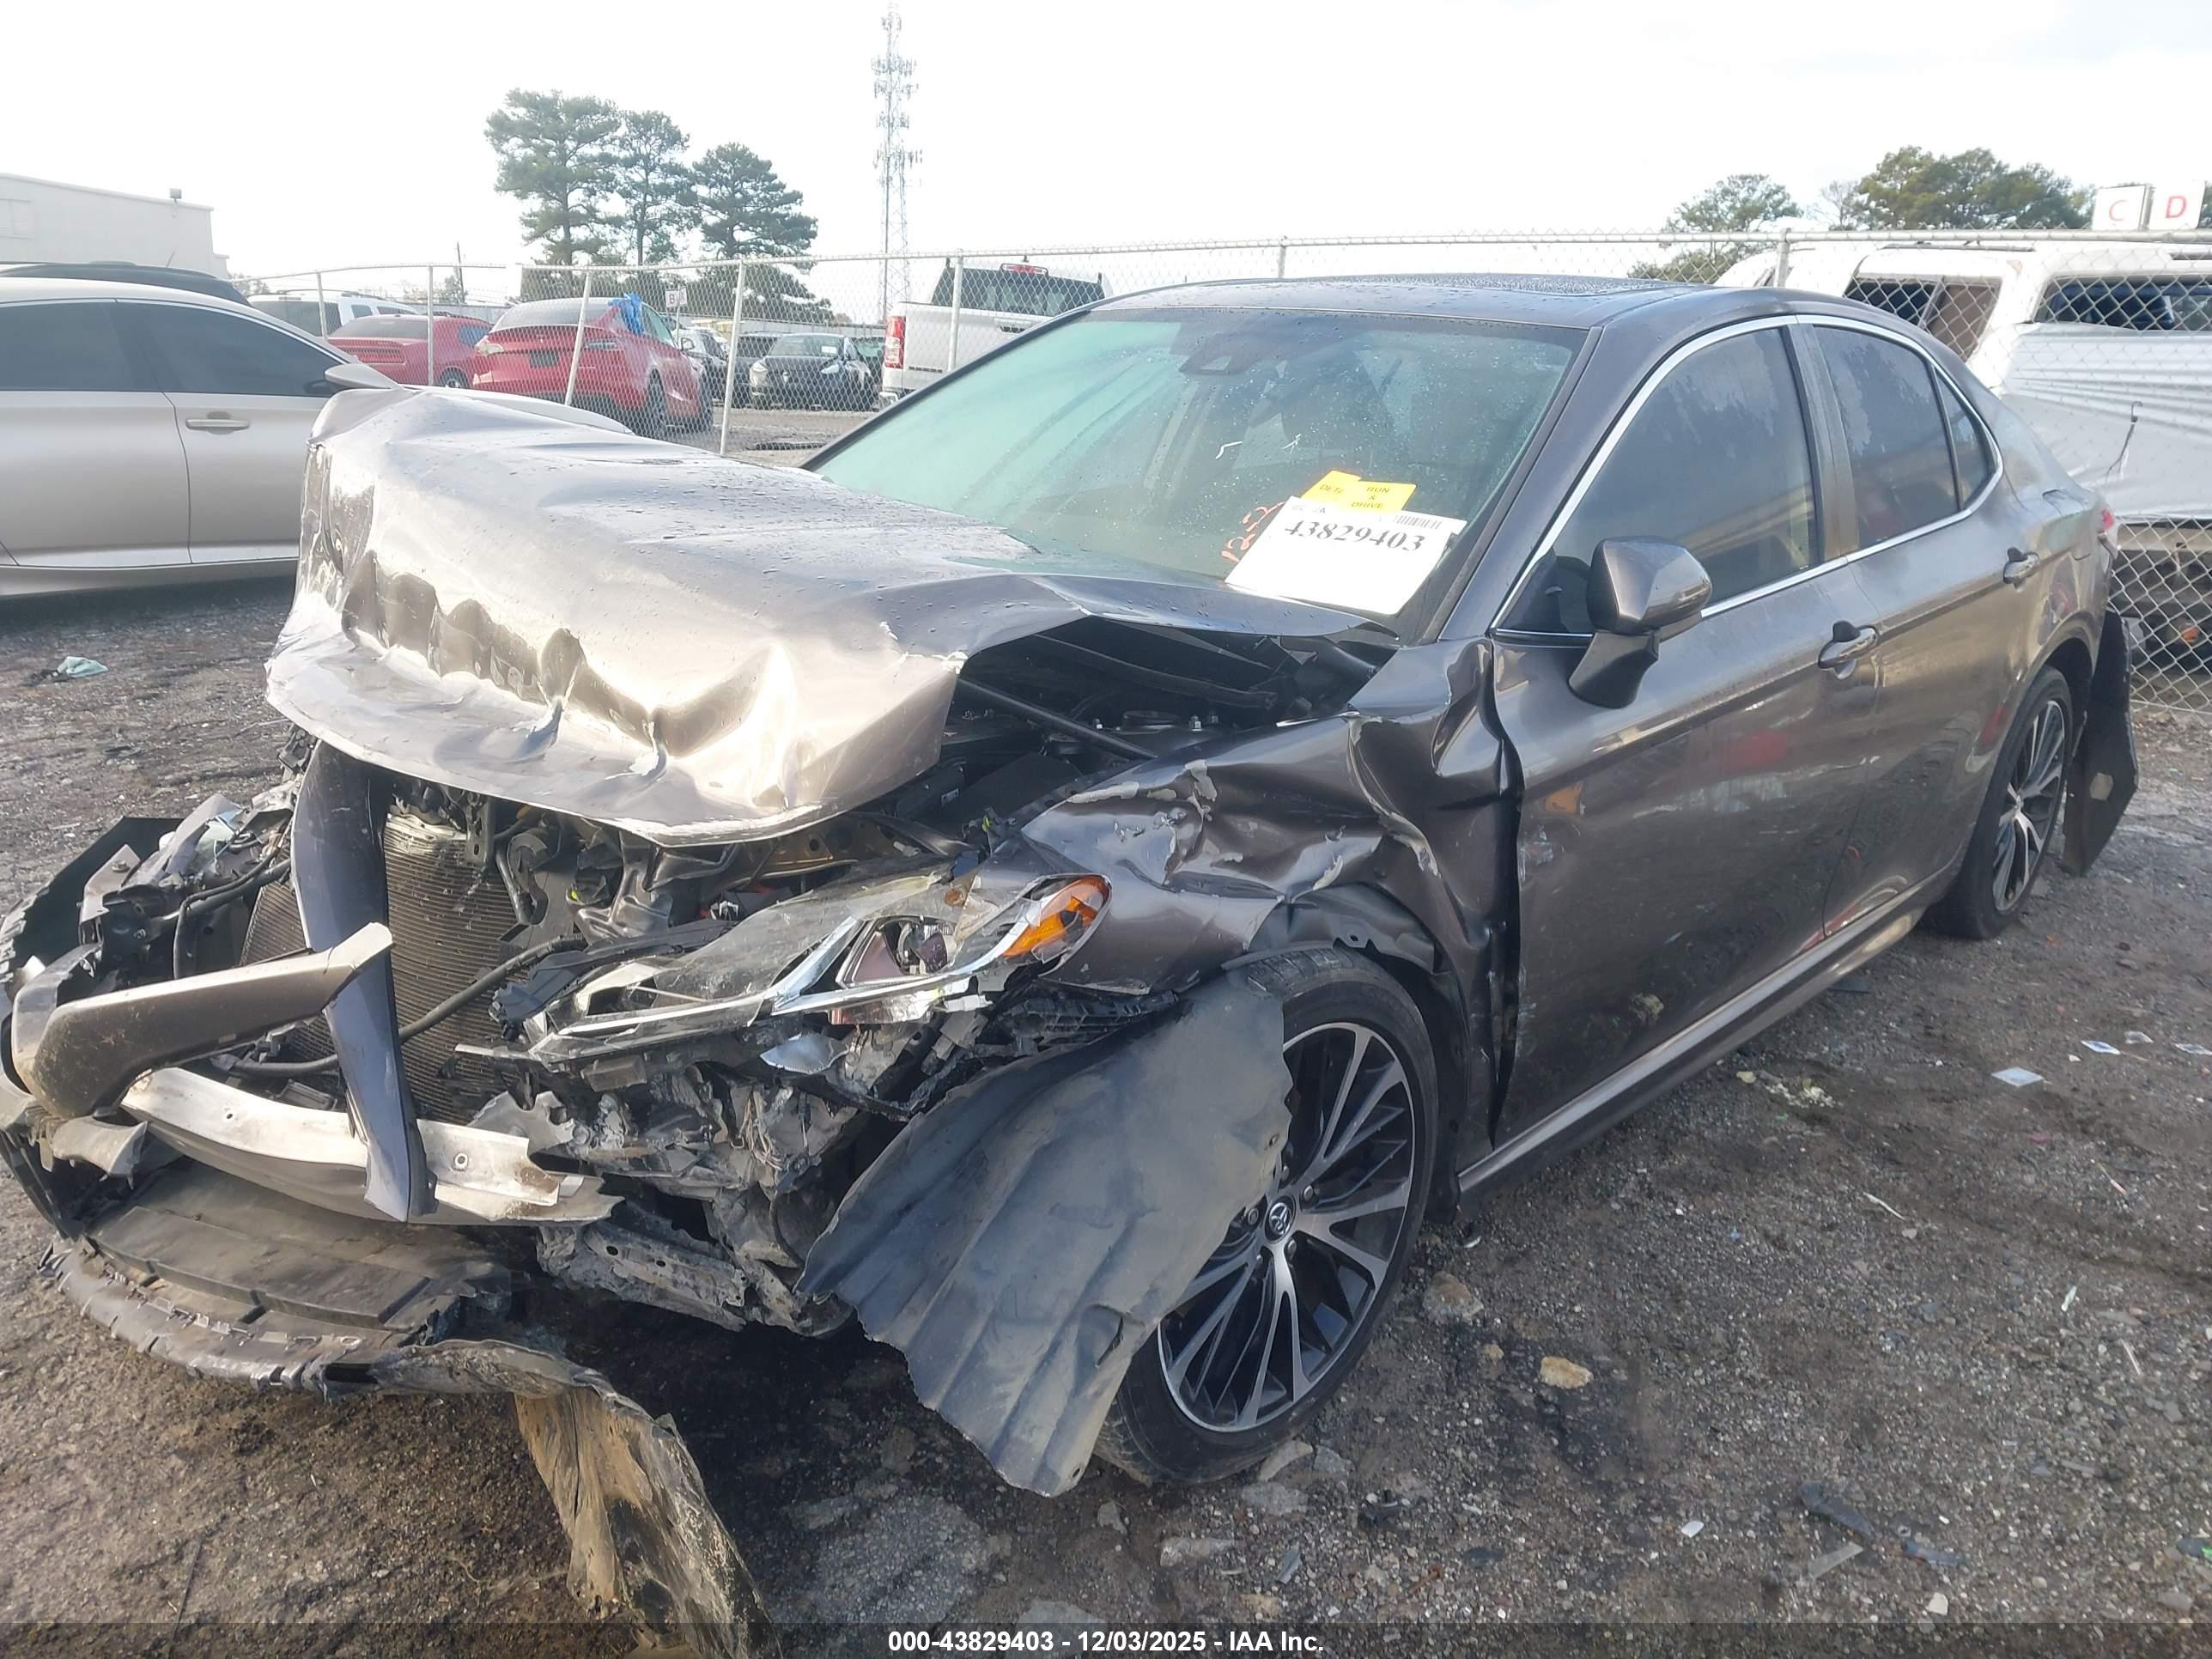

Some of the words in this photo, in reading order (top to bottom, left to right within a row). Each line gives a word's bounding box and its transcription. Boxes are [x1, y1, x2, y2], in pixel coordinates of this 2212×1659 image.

[2109, 199, 2128, 222] C
[2165, 195, 2188, 219] D
[1285, 520, 1425, 551] 43829403
